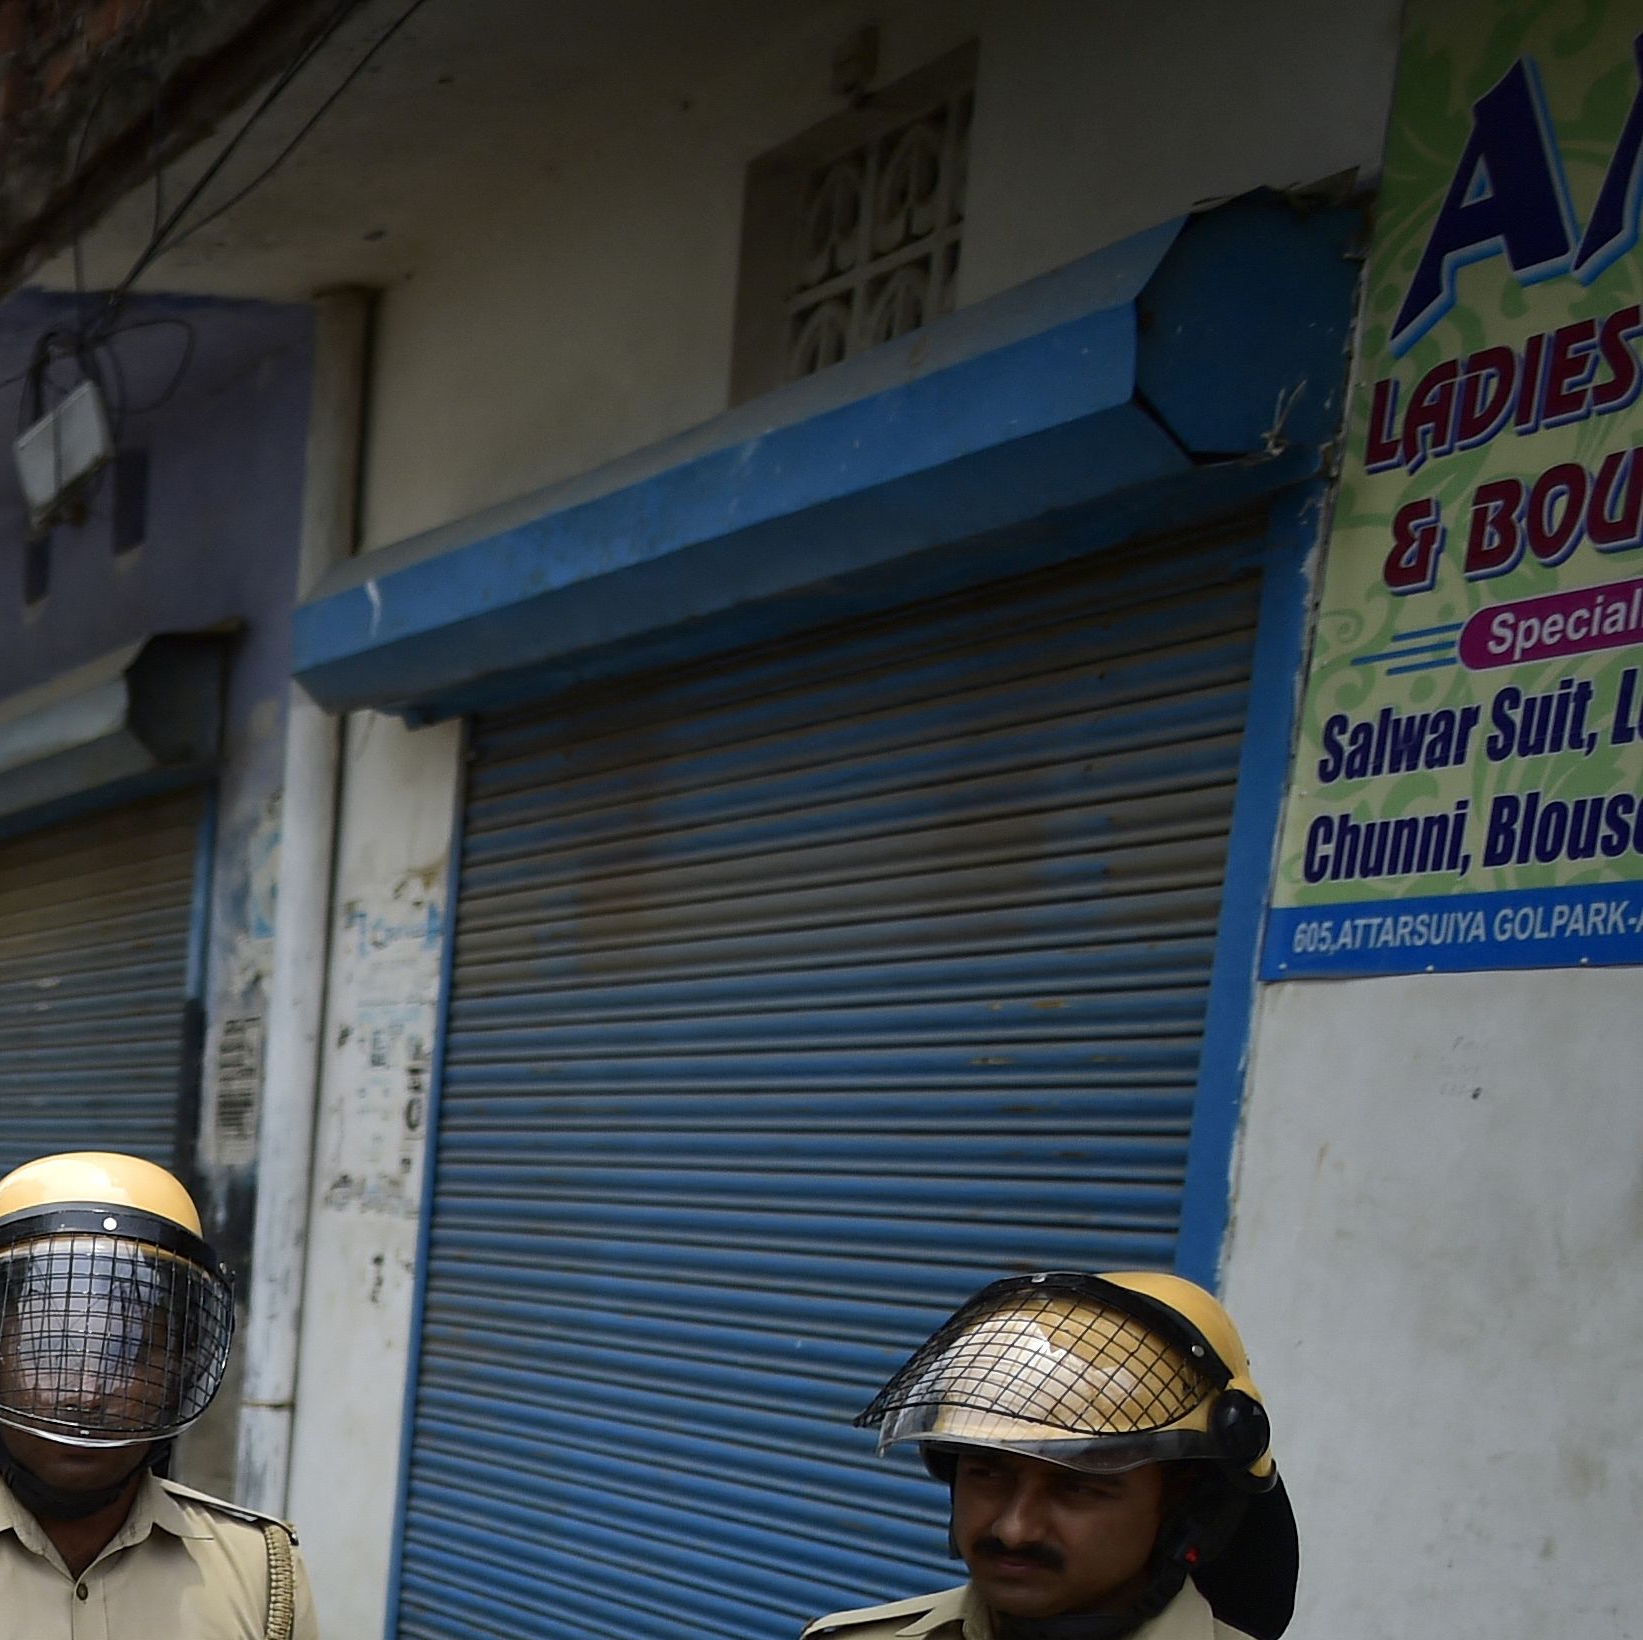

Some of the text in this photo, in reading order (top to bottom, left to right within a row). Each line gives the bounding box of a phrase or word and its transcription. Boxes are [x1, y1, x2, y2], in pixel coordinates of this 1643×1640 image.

[1365, 303, 1643, 476] LADIES
[1383, 497, 1447, 596] &
[1318, 667, 1643, 784] Salwar Suit, L
[1303, 800, 1472, 884] Chunni,
